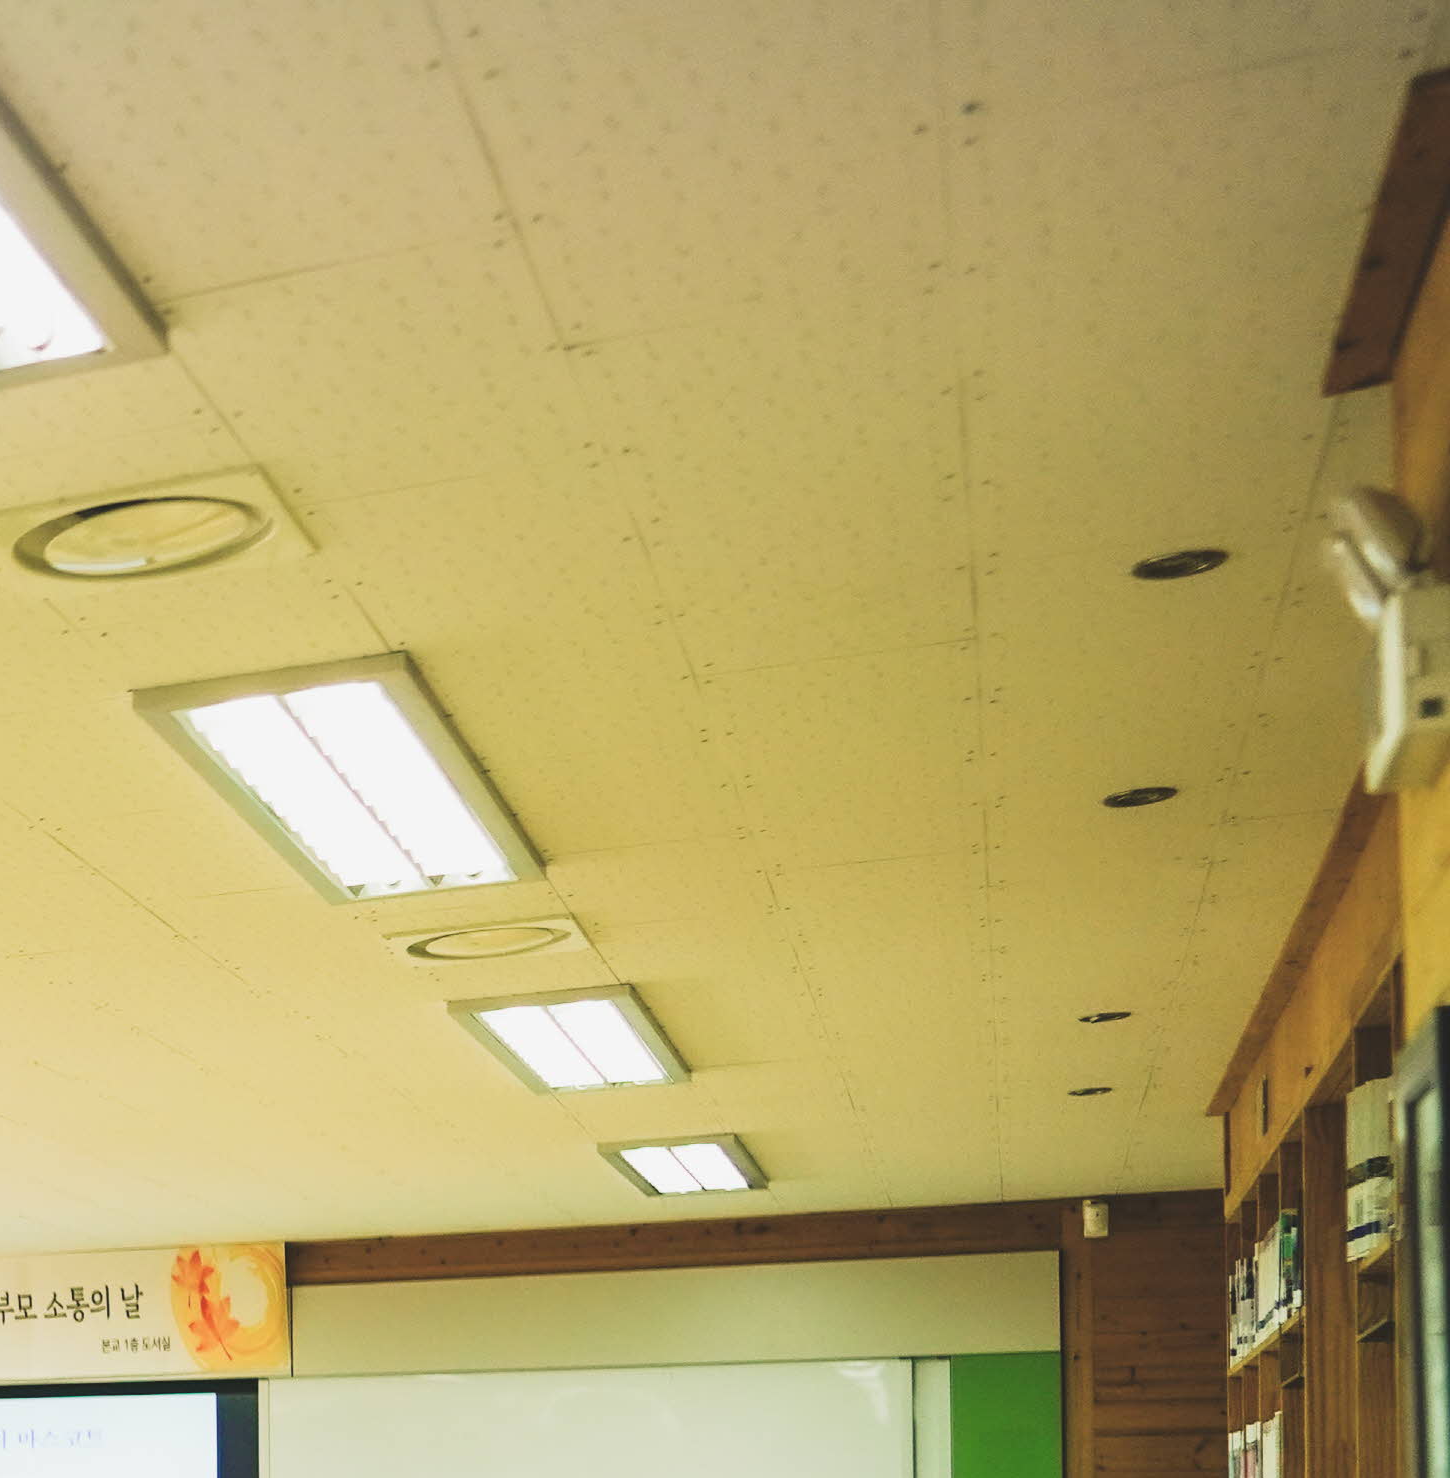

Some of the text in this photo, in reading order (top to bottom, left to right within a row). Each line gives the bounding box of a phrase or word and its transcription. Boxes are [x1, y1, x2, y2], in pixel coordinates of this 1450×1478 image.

[43, 1286, 112, 1322] 소통의
[121, 1283, 144, 1320] 날
[142, 1335, 171, 1351] 도서실
